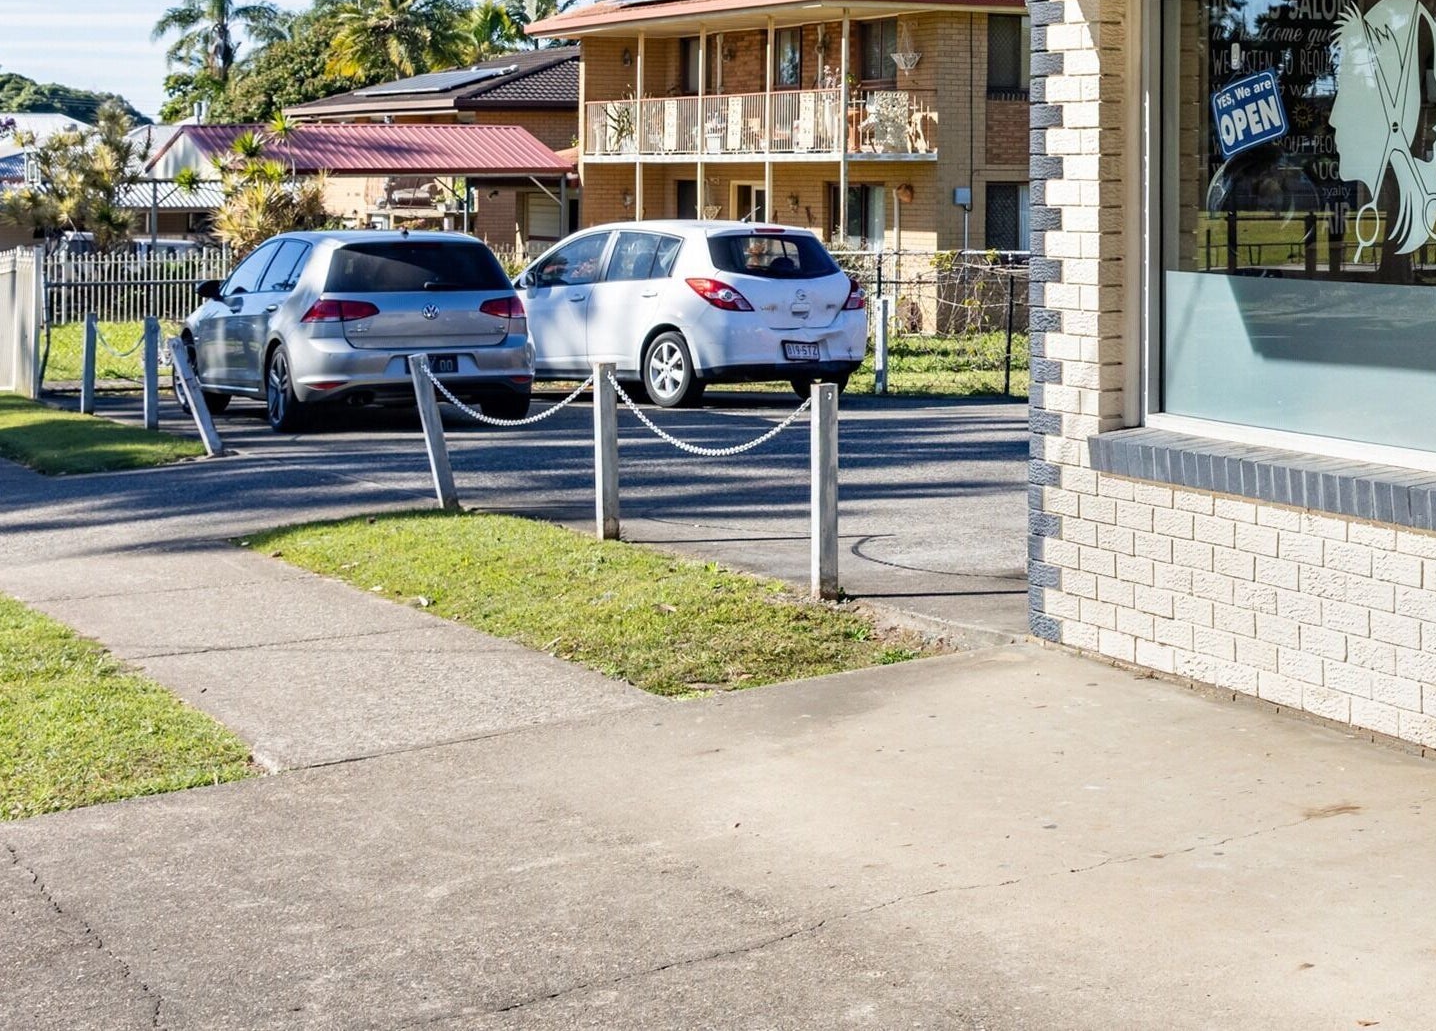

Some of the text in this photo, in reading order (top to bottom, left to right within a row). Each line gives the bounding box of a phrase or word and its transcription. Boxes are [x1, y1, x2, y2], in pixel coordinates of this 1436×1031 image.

[1216, 94, 1235, 110] YES,
[1234, 84, 1251, 100] We
[1253, 79, 1272, 95] are
[1220, 95, 1281, 147] OPEN
